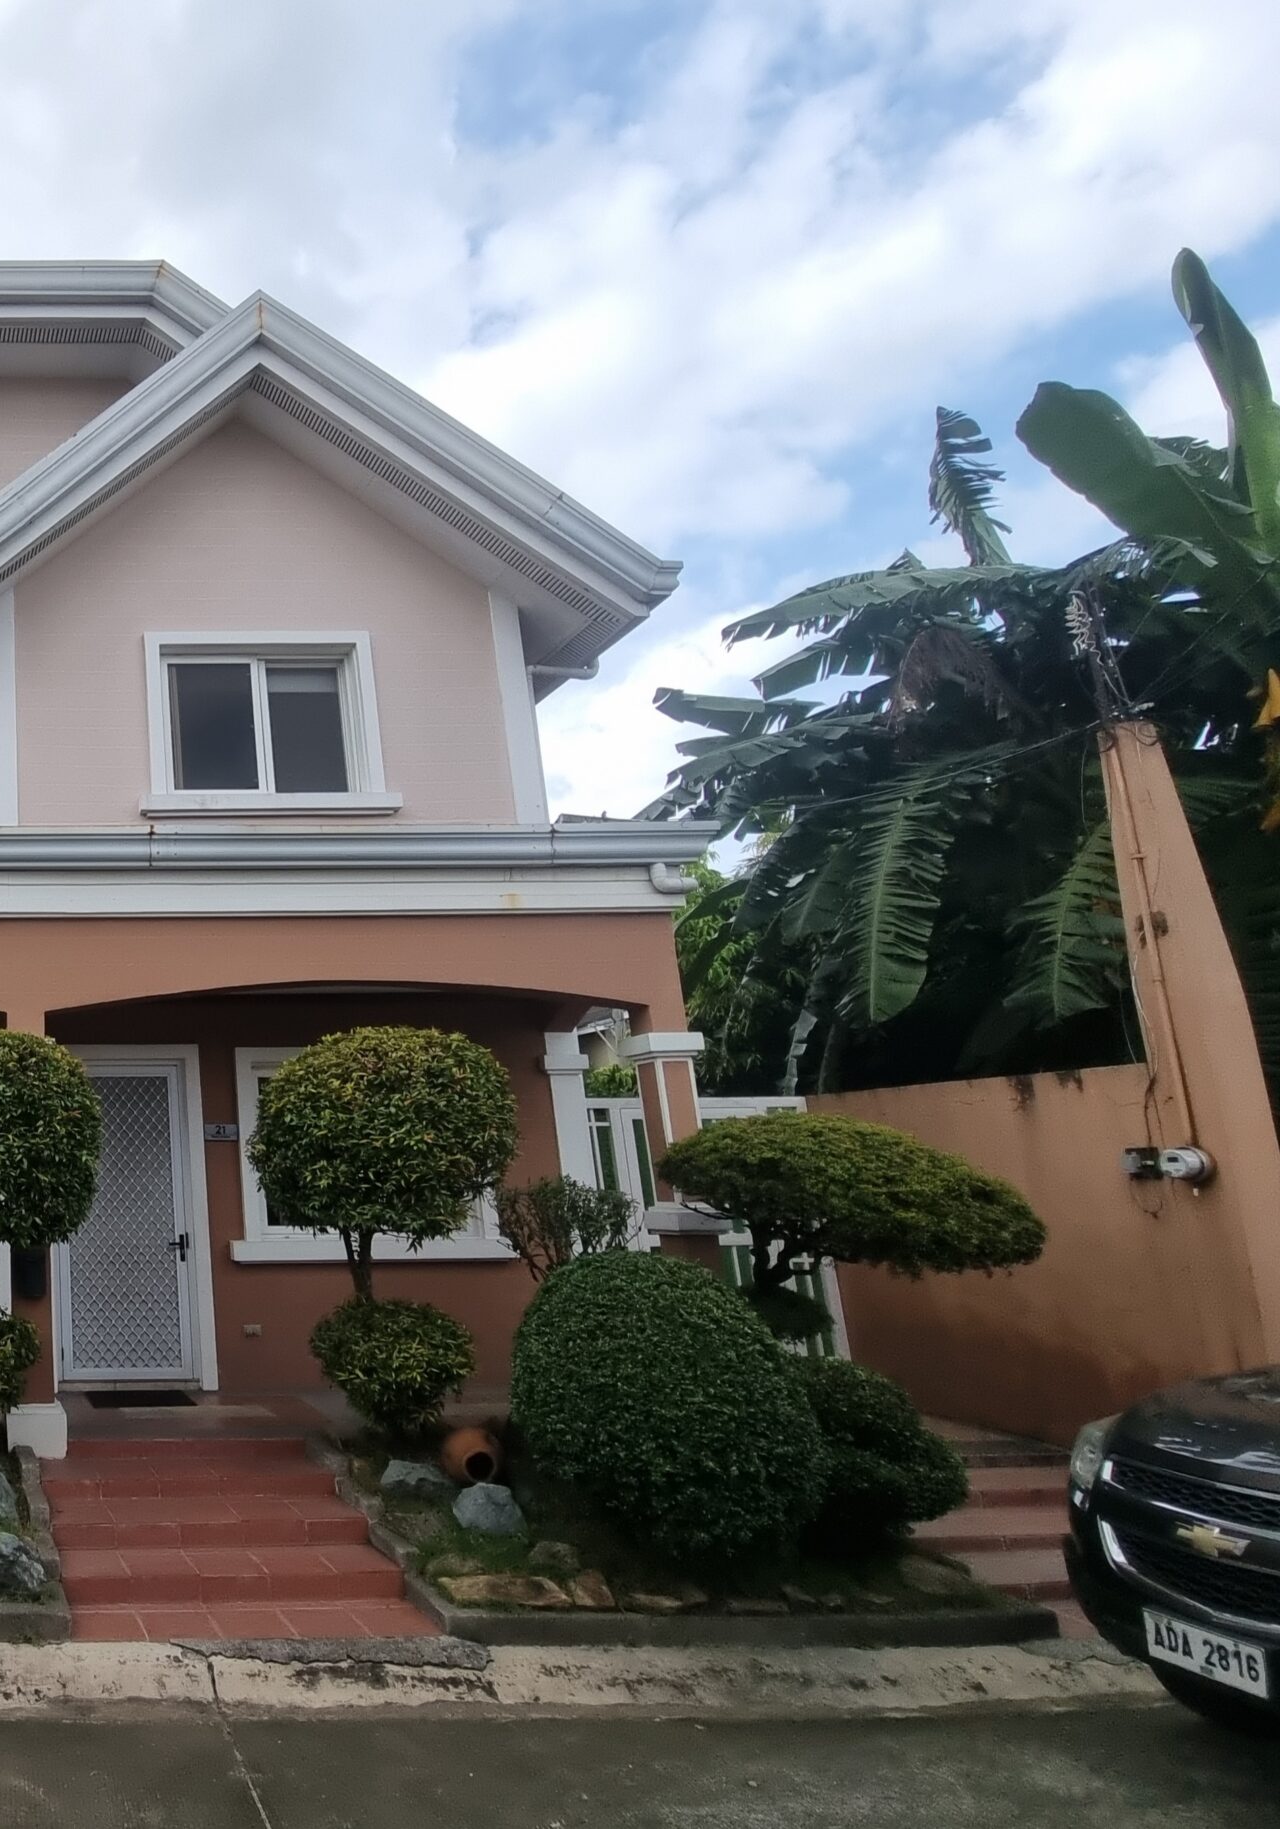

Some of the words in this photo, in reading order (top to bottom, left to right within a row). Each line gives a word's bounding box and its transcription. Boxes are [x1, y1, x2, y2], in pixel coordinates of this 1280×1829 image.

[215, 1125, 226, 1135] 21
[1154, 1621, 1194, 1660] ADA
[1202, 1638, 1260, 1683] 2816
